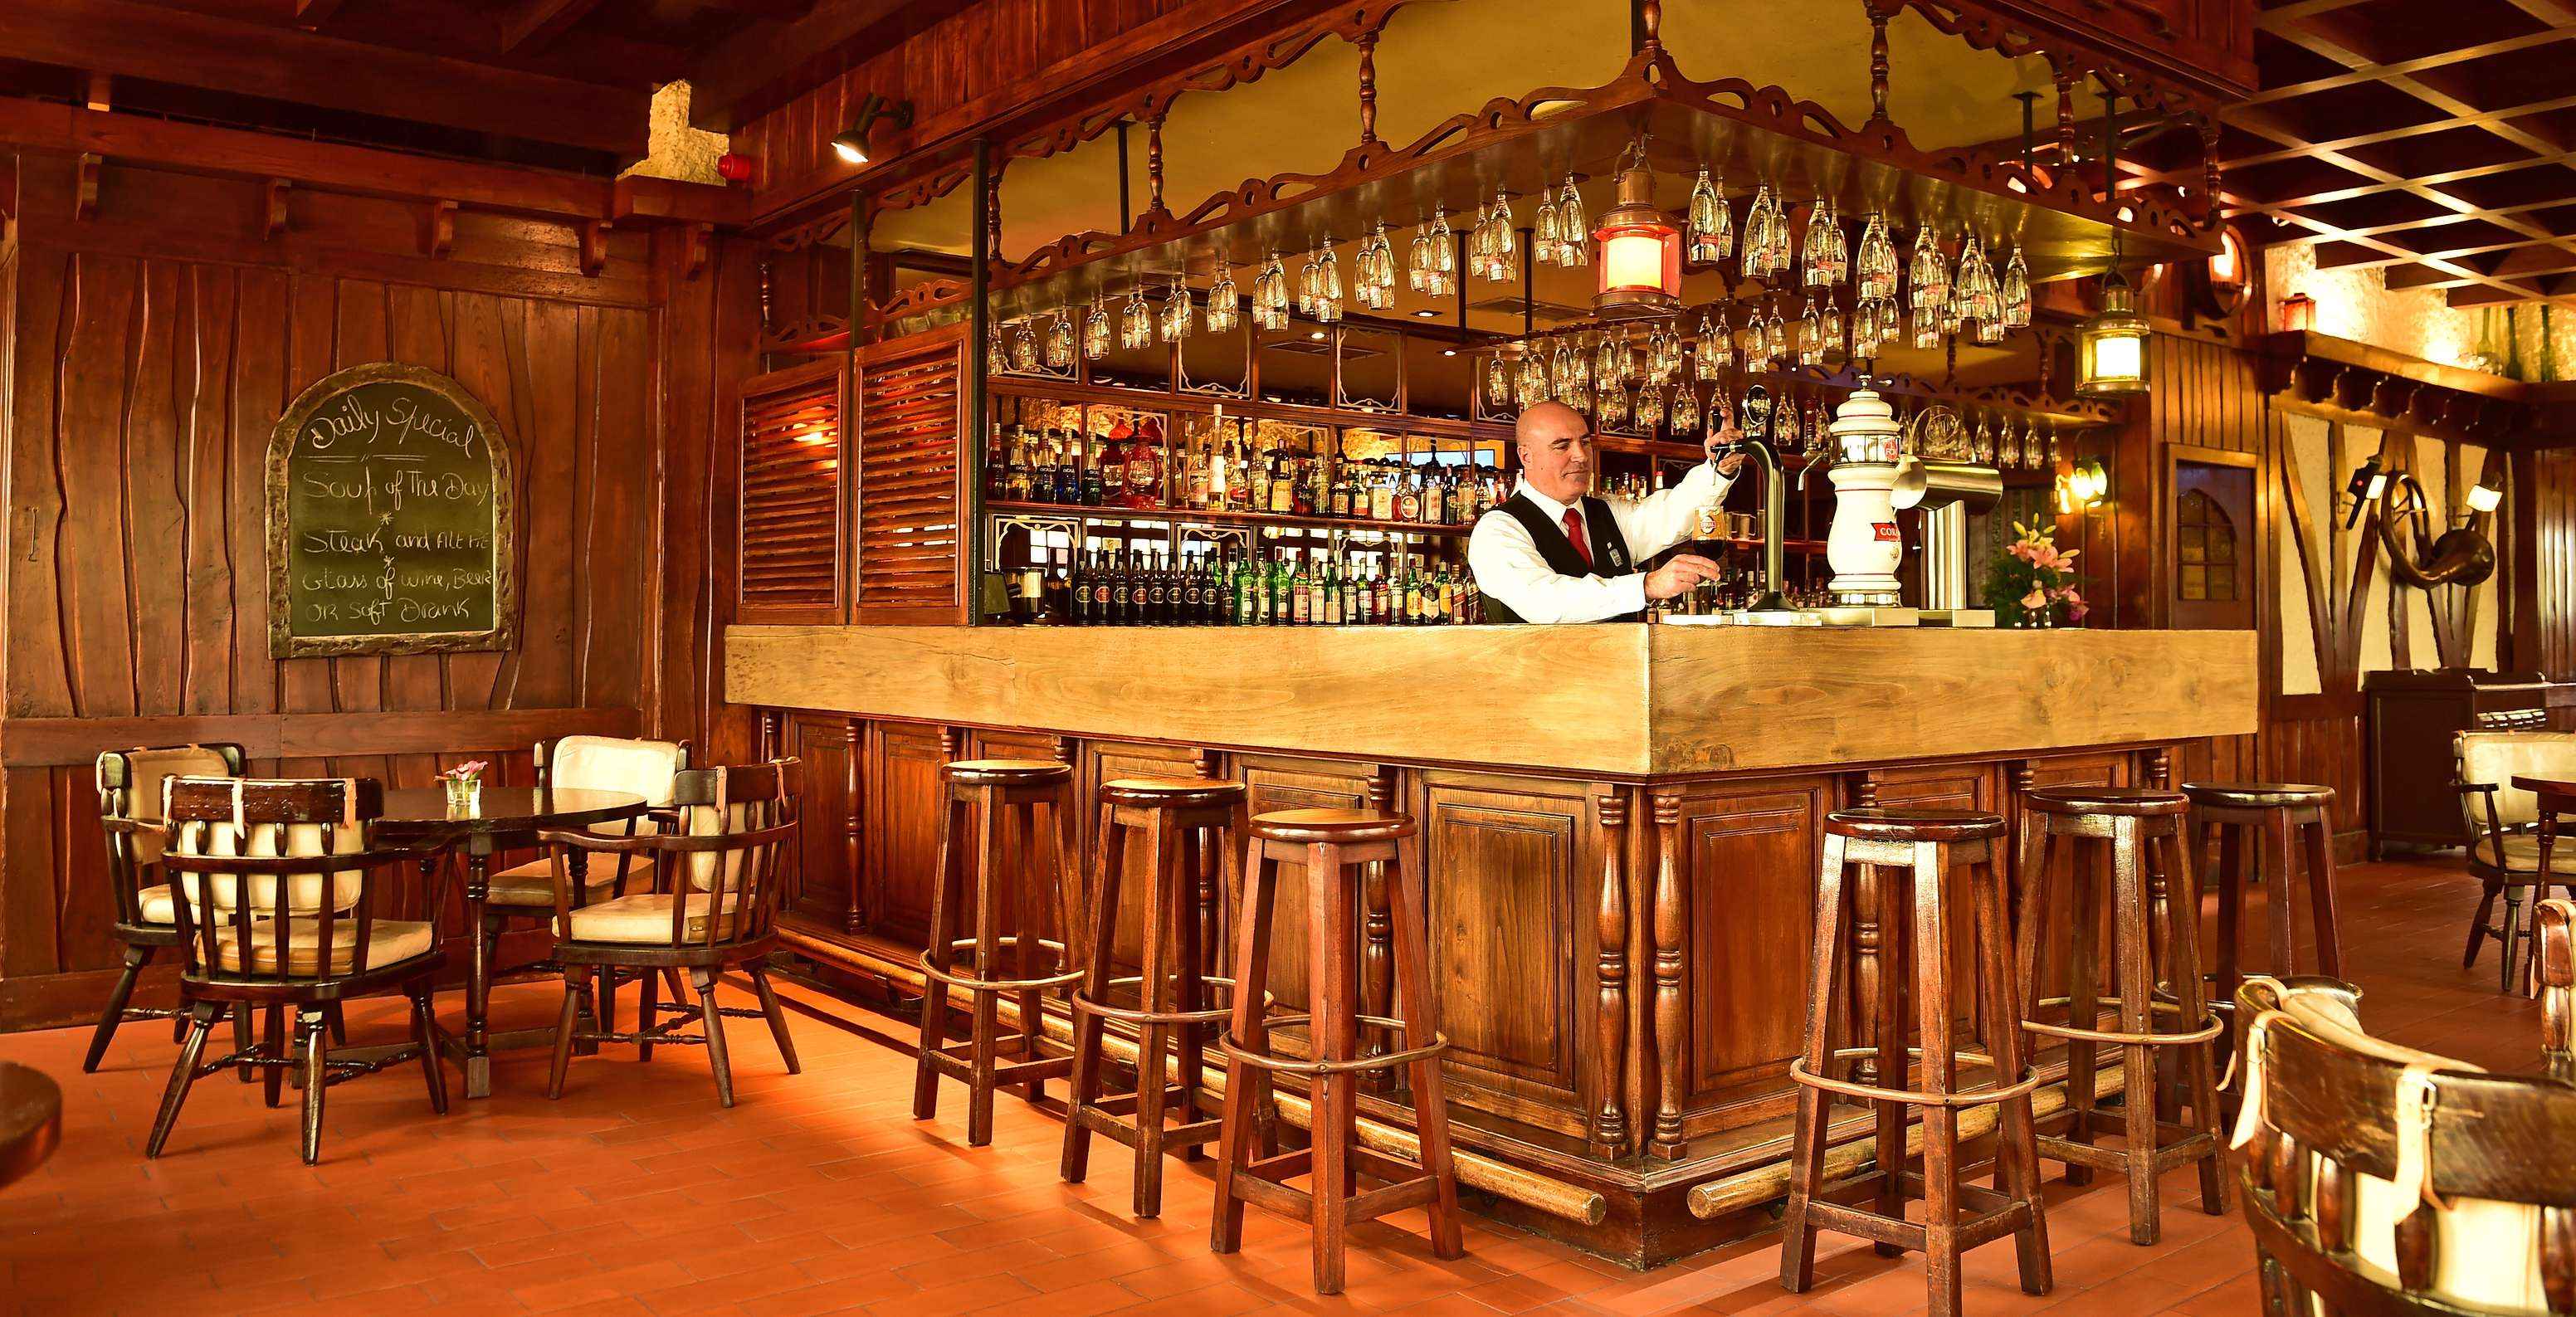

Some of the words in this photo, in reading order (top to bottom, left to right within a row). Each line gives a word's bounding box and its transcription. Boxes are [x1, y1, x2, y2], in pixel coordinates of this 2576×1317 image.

[311, 394, 379, 449] Daily
[386, 398, 474, 458] Special
[302, 466, 378, 515] Soup
[384, 470, 403, 511] of
[406, 471, 439, 497] The
[442, 472, 490, 507] Day
[304, 526, 384, 554] Steak
[395, 532, 432, 552] and
[375, 567, 397, 600] of
